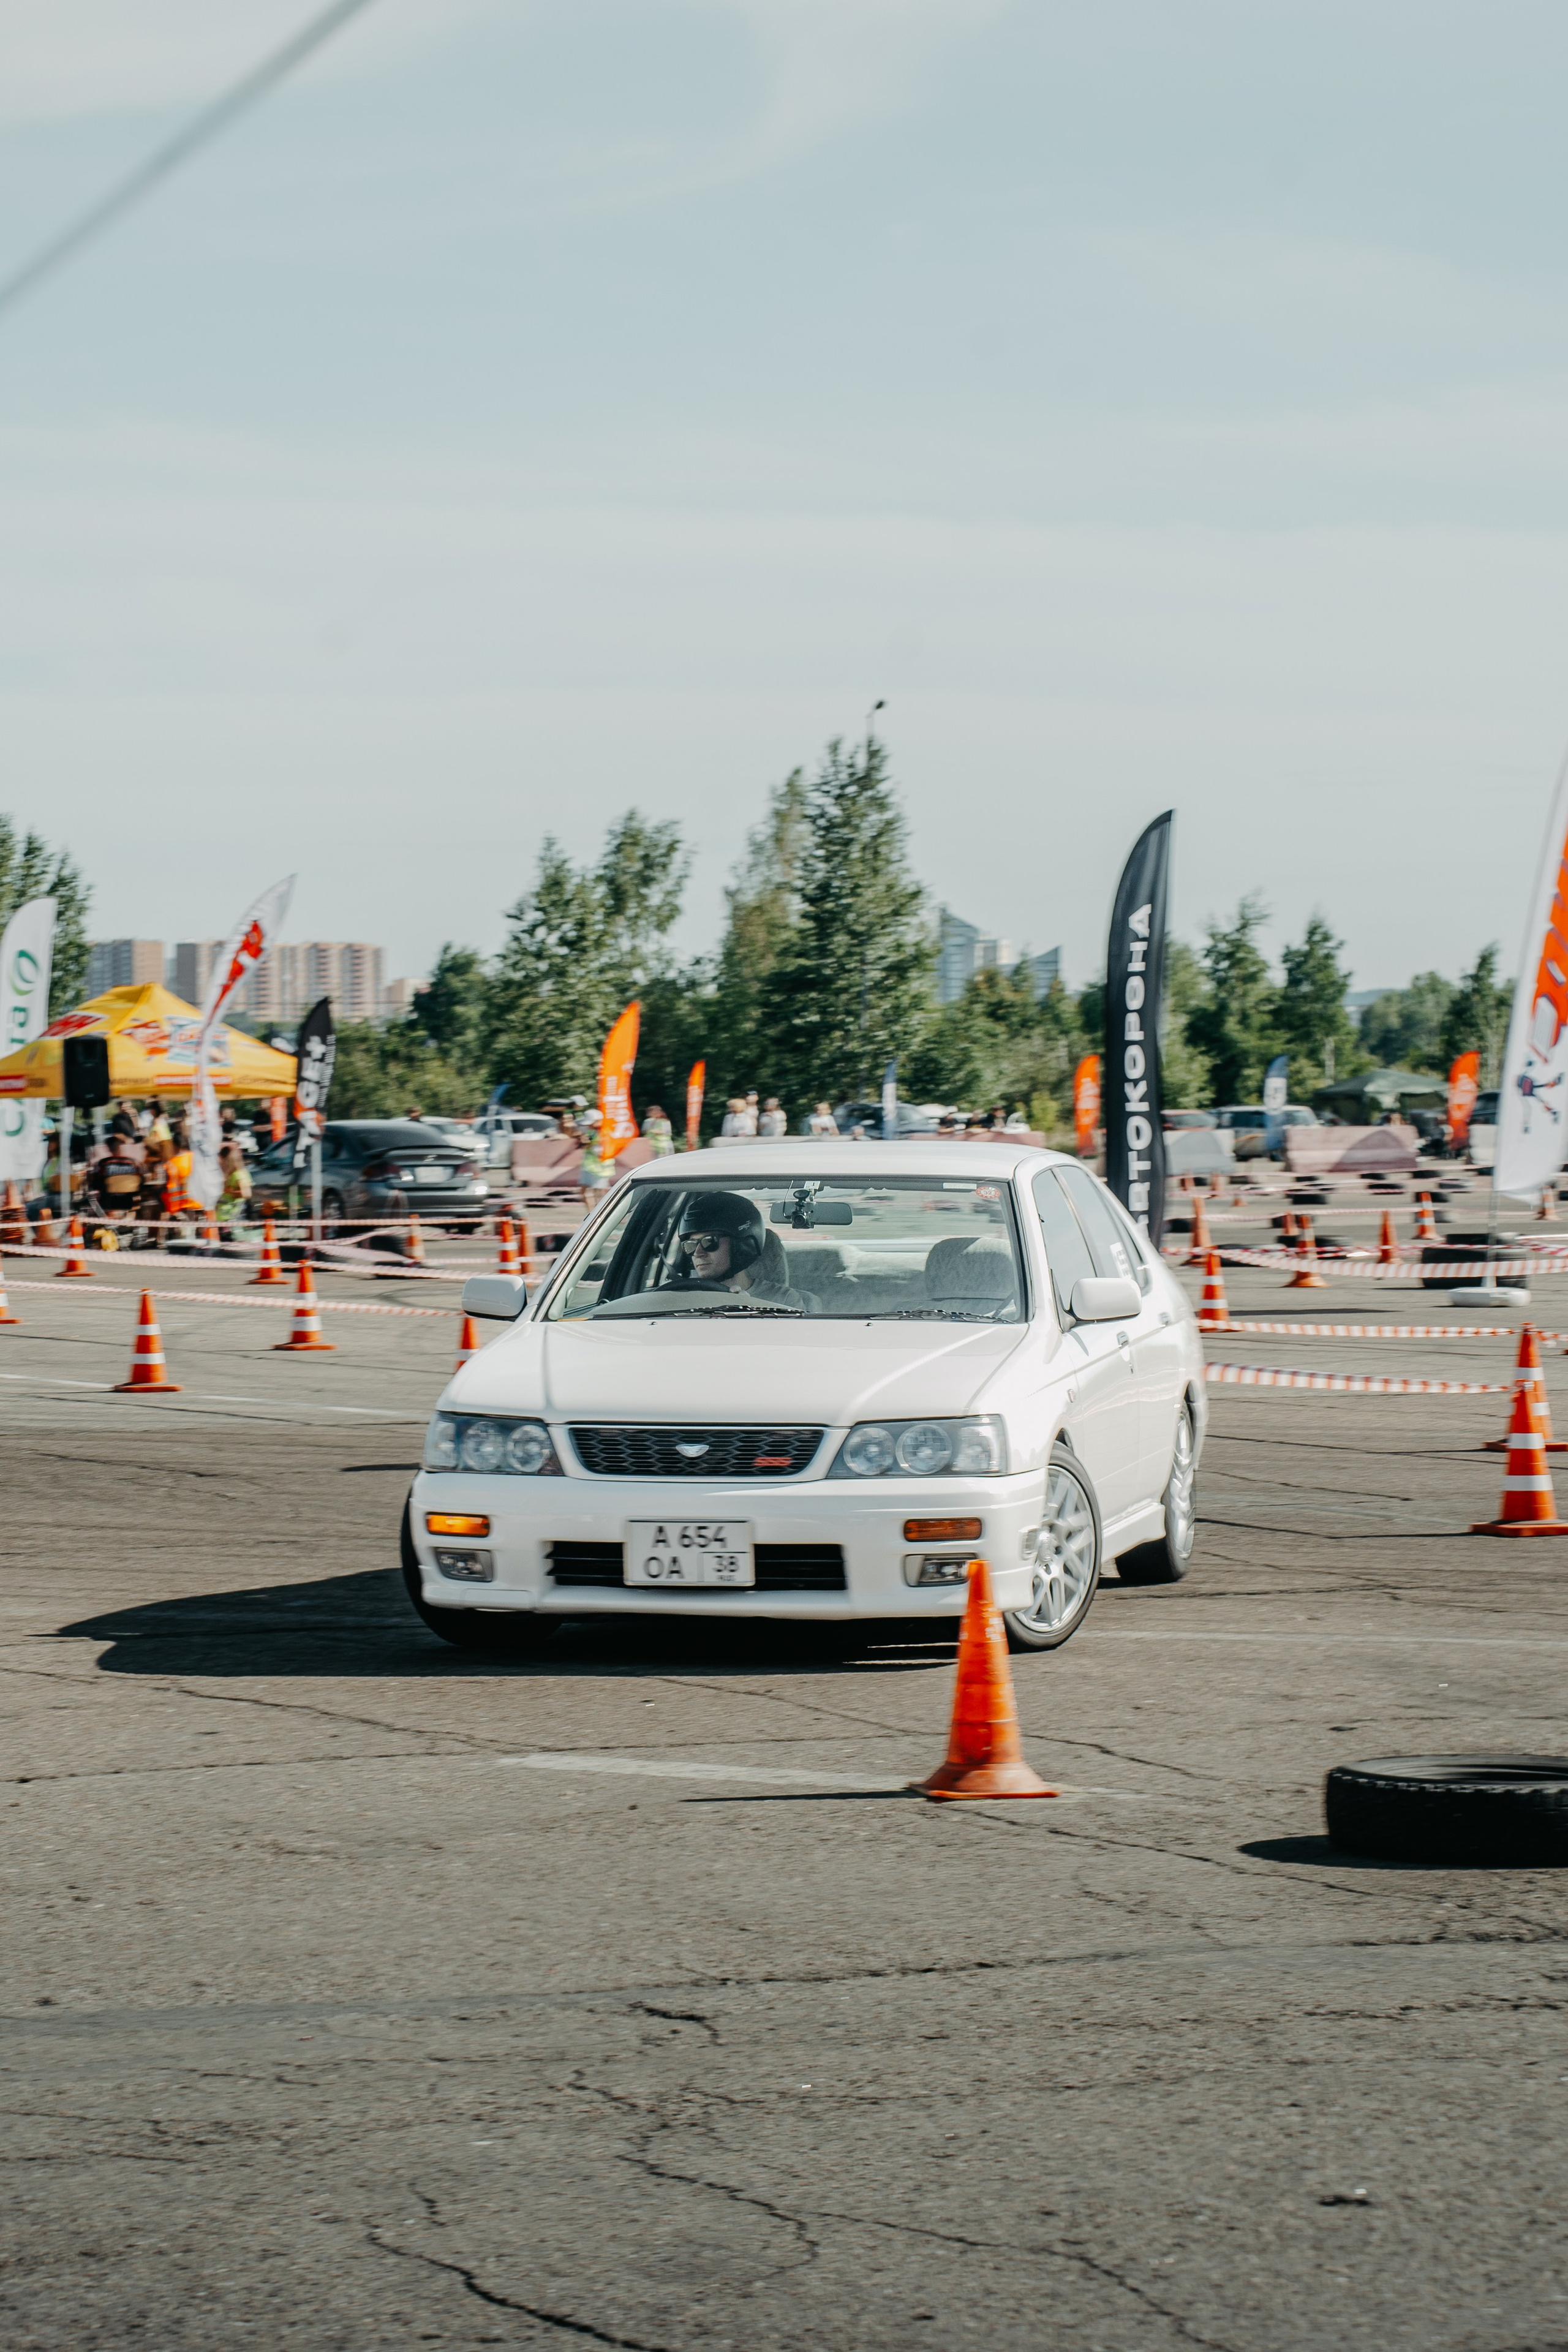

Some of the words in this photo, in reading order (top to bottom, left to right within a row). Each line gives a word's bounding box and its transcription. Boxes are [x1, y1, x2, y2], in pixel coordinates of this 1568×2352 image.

[1124, 903, 1152, 1230] ВТОКОРОНА
[677, 1525, 728, 1548] 654
[712, 1555, 739, 1573] 38
